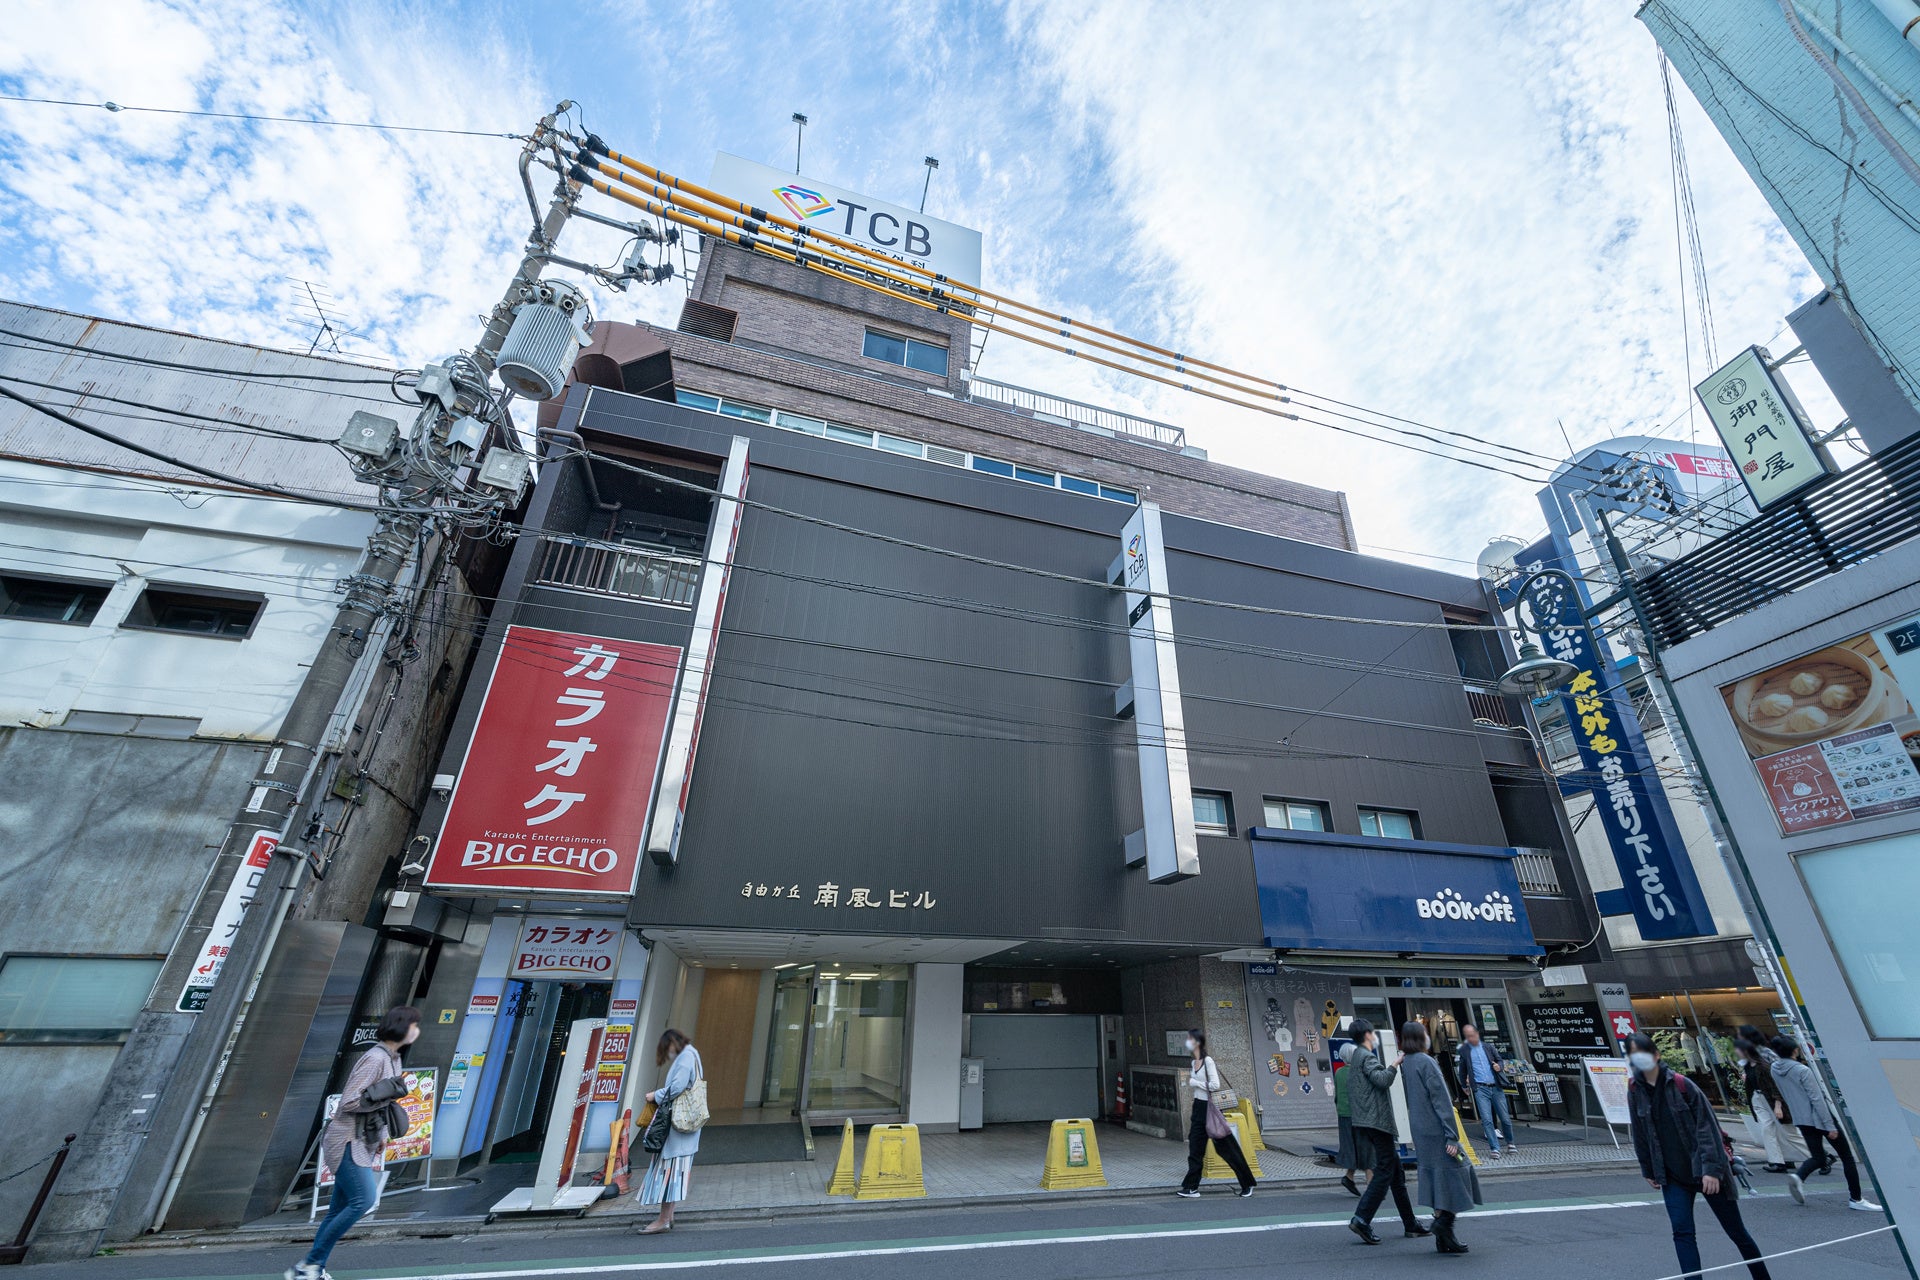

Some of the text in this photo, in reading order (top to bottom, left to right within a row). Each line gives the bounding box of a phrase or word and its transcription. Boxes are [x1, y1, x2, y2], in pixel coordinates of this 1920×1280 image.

[837, 198, 931, 257] TCB
[1730, 399, 1795, 481] 御門屋
[1128, 553, 1144, 579] TCB
[1895, 630, 1918, 648] 2F
[523, 643, 620, 826] カラオケ
[1779, 794, 1842, 816] テイクアウト
[1784, 809, 1829, 825] やってます
[484, 830, 608, 845] Karaoke Entertainment
[461, 840, 619, 873] BIG ECHO
[741, 881, 937, 910] 自由が丘 南風ビル
[525, 925, 618, 945] カラオケ
[518, 954, 612, 972] BIG ECHO
[1251, 978, 1348, 994] 秋冬服そろいました
[1534, 1007, 1584, 1016] FLOOR GUIDE
[352, 1028, 369, 1044] BIG
